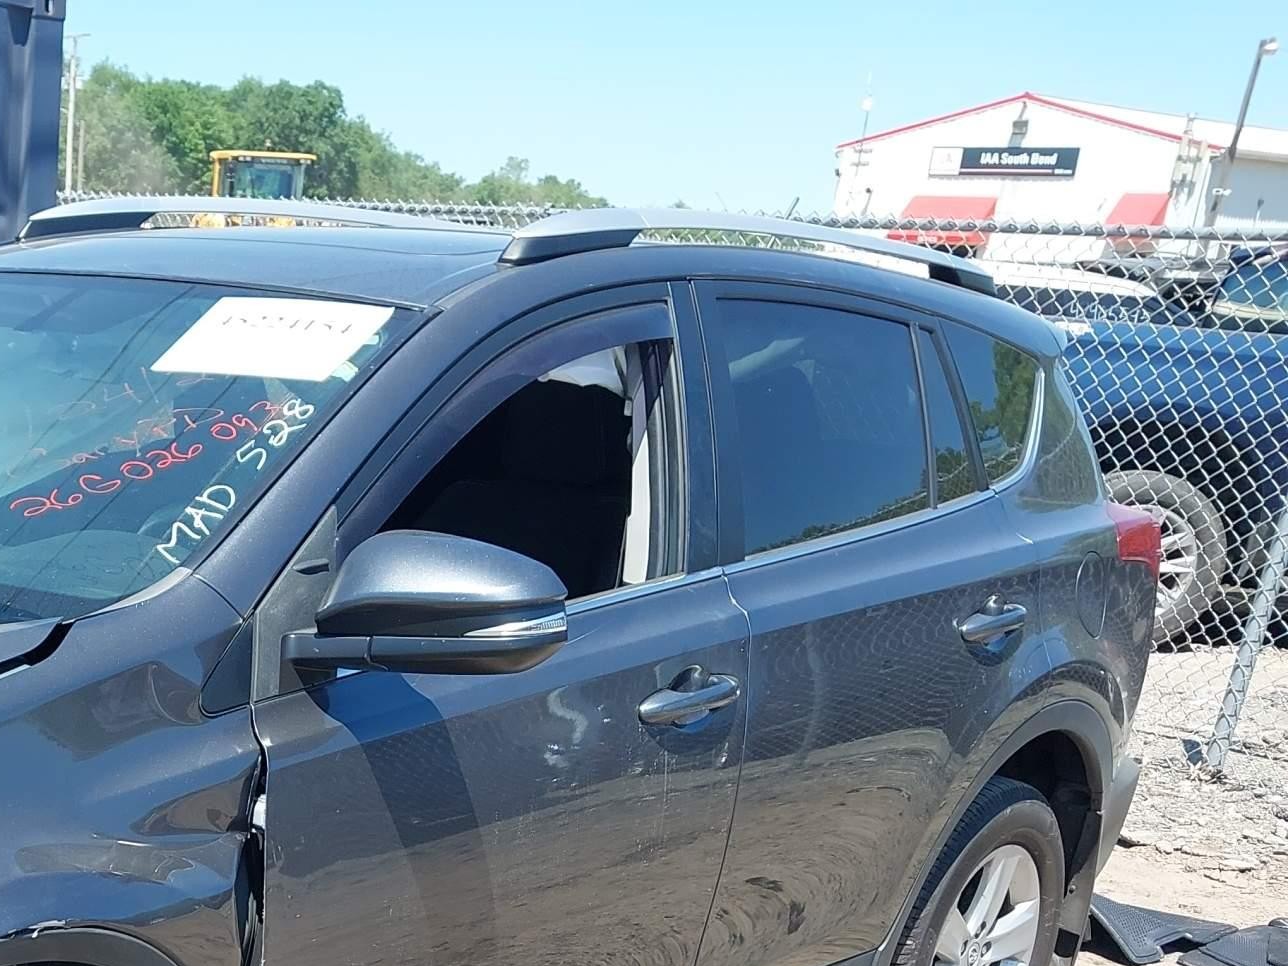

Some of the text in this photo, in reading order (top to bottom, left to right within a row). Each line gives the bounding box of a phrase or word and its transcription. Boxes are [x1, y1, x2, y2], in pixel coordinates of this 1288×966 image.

[980, 152, 1058, 166] IAA South Bend
[156, 484, 236, 564] MAD
[236, 398, 315, 471] 528
